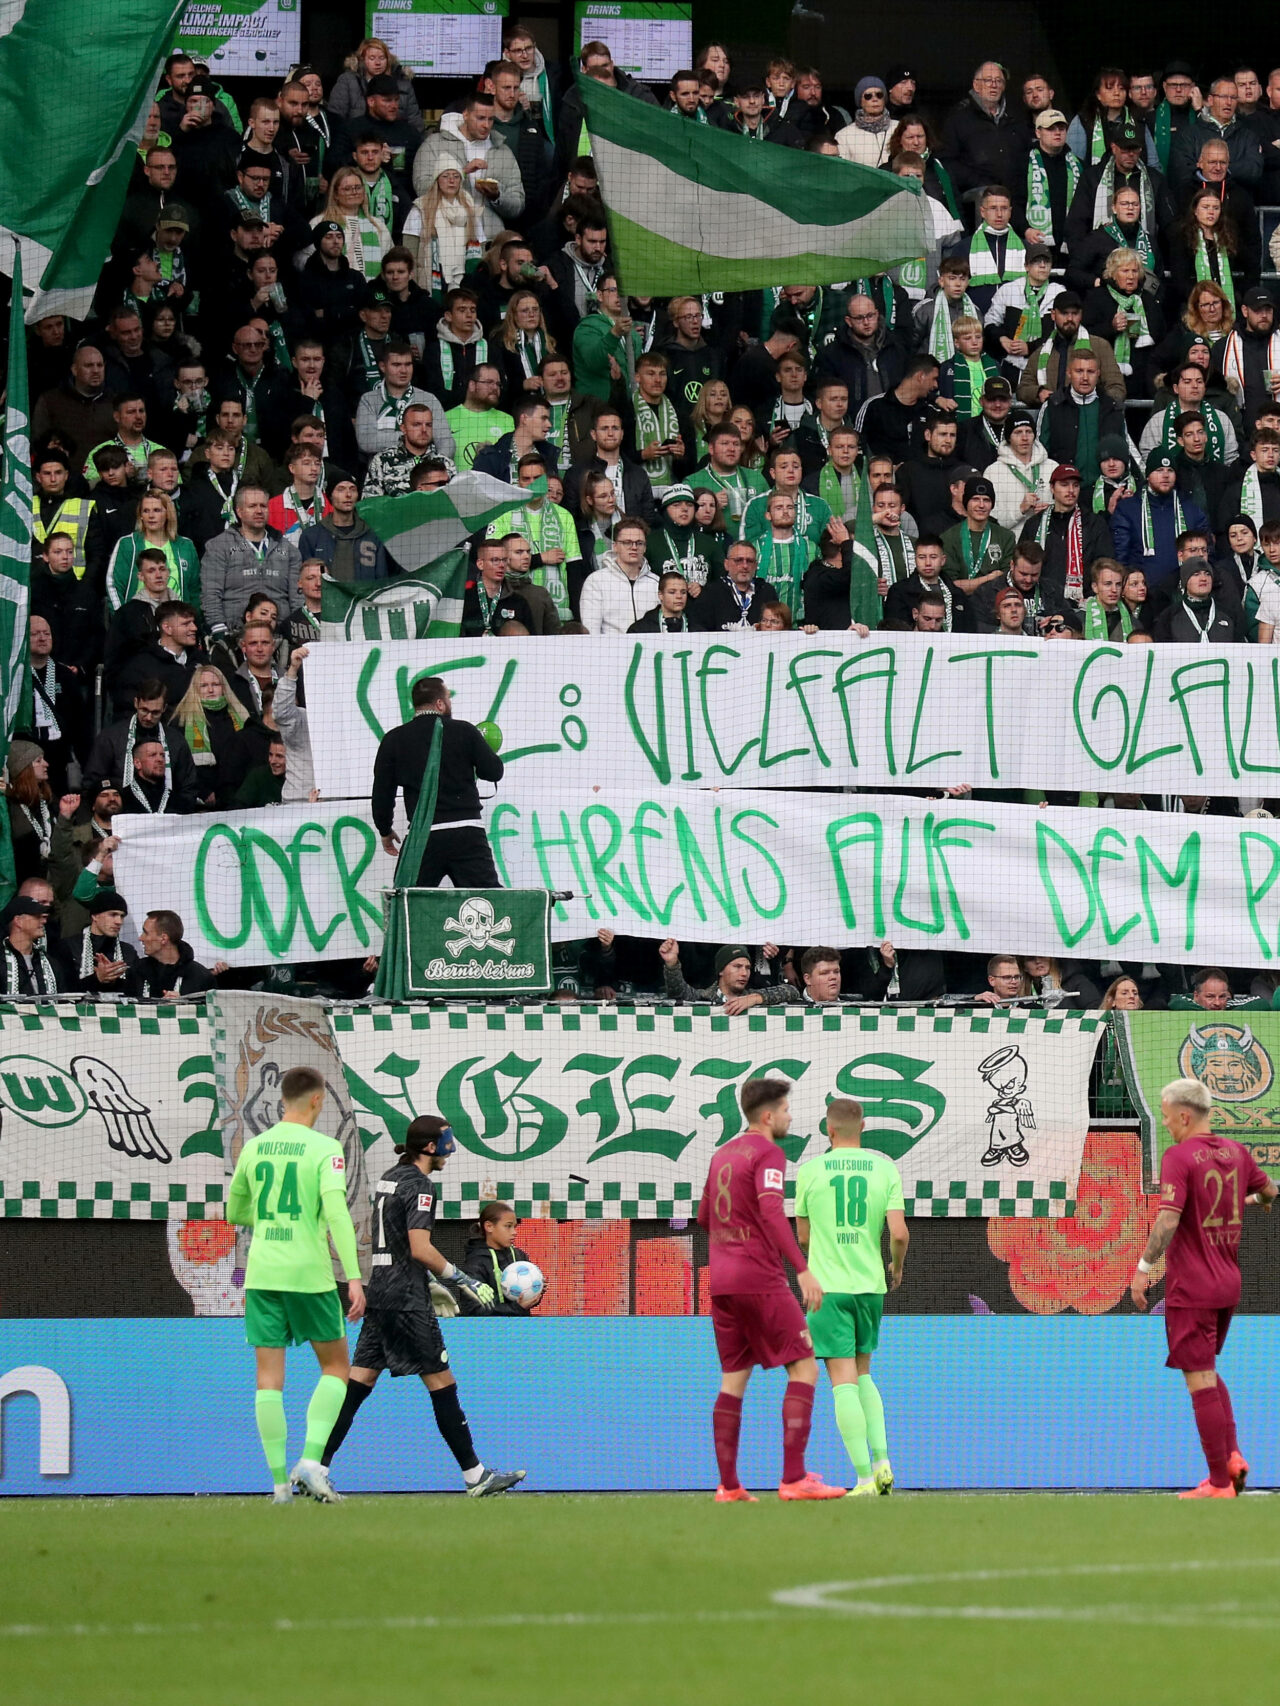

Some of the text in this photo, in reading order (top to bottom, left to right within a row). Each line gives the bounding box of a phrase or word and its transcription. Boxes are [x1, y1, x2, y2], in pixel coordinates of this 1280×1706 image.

[586, 4, 621, 15] DRINKS
[624, 642, 1038, 797] VIELFALT
[194, 815, 386, 958] ODER
[487, 802, 787, 942] EHRENS
[825, 811, 996, 941] AUF
[1036, 820, 1201, 952] DEM
[425, 958, 535, 980] Bernie bei uns
[179, 1051, 947, 1165] NGELS
[257, 1142, 307, 1157] WOLFSBURG
[824, 1159, 873, 1172] WOLFSBURG
[255, 1160, 303, 1221] 24
[714, 1162, 733, 1224] 8
[829, 1174, 868, 1228] 18
[1202, 1167, 1243, 1228] 21
[376, 1195, 386, 1249] 1
